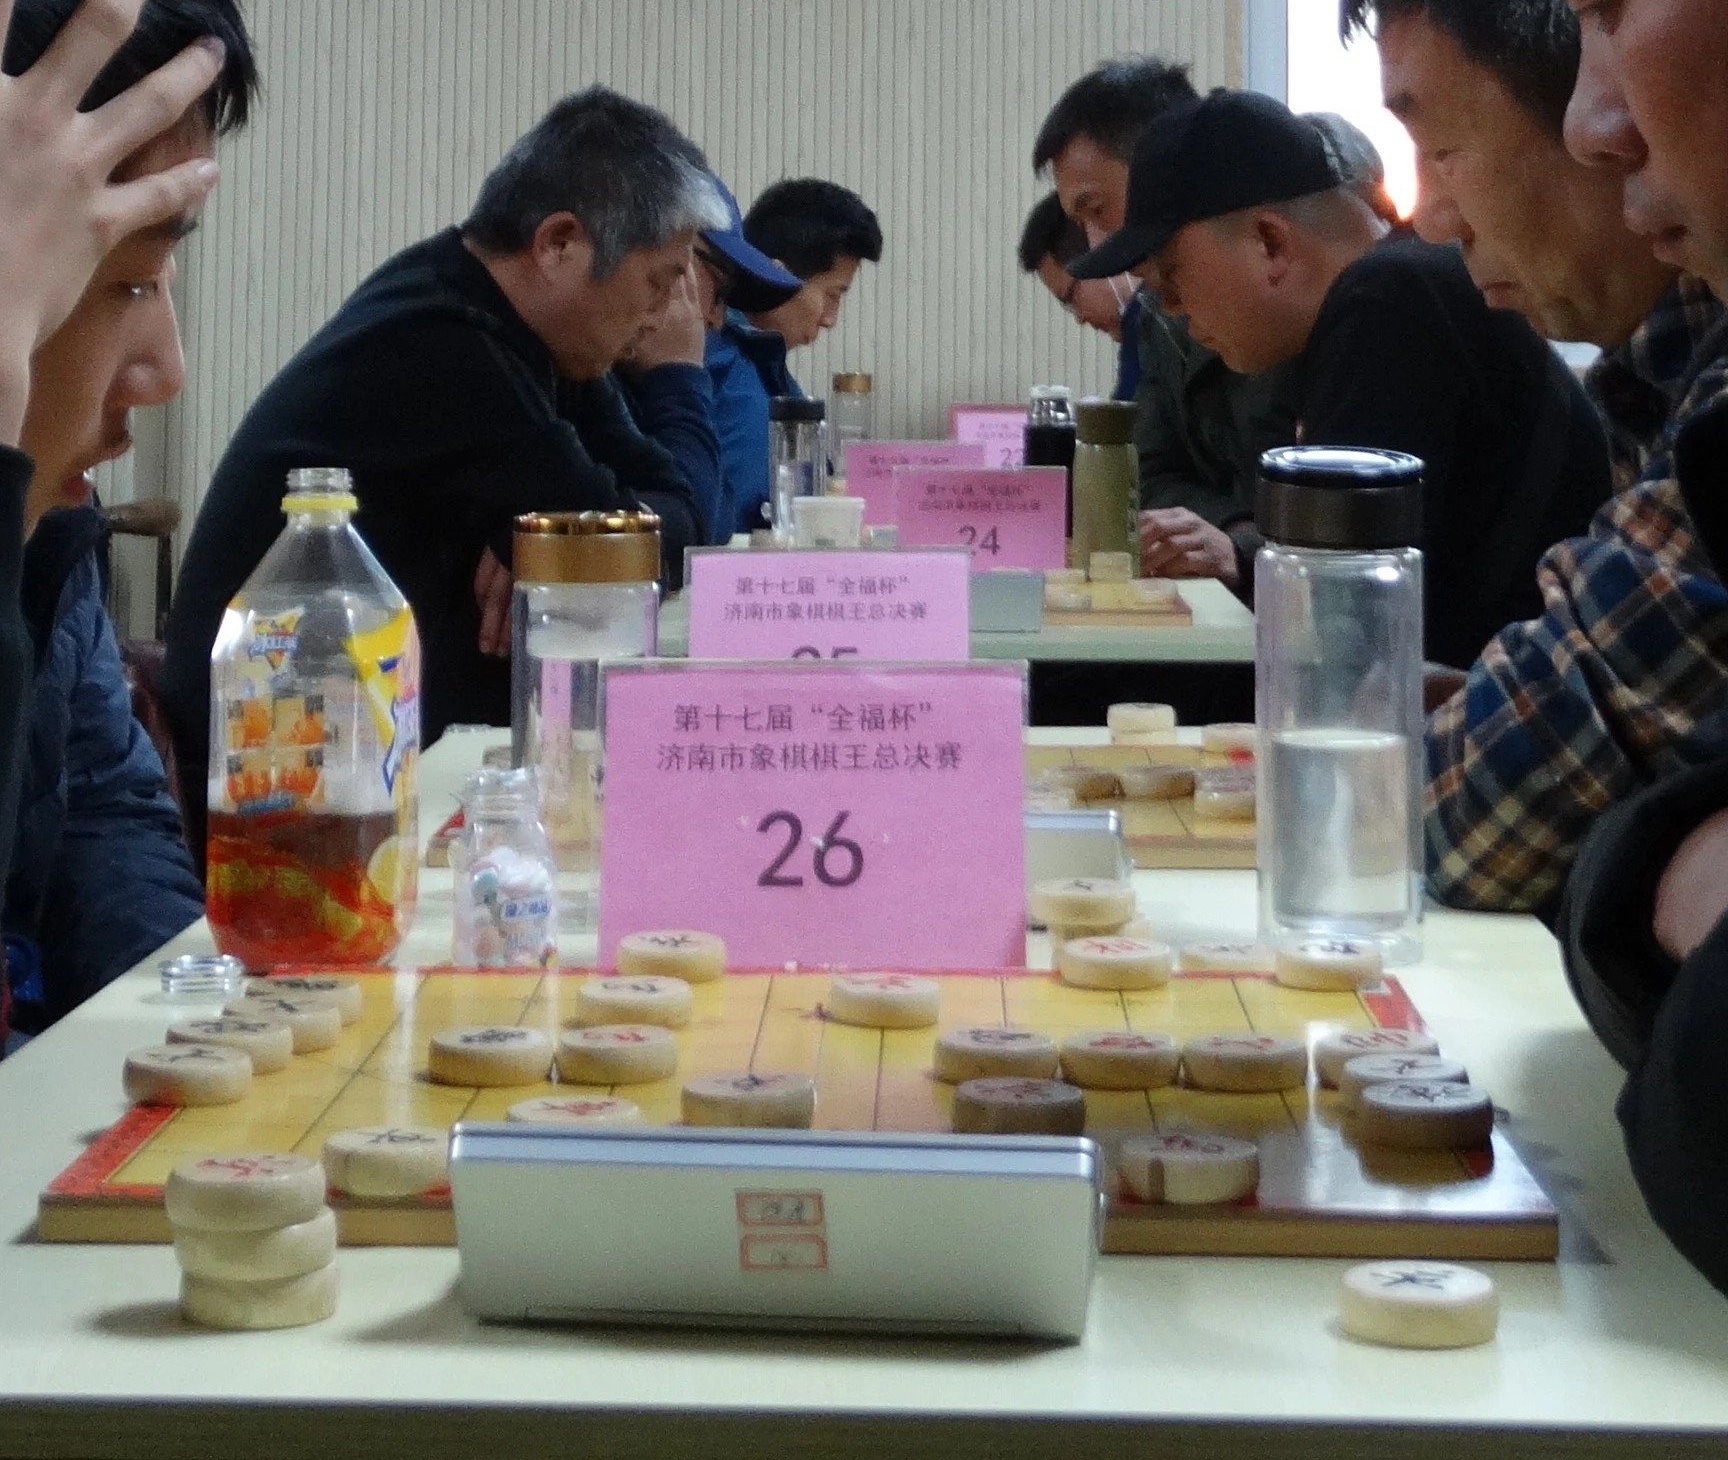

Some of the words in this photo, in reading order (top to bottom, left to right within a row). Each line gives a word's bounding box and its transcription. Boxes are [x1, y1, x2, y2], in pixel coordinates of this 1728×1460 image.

[958, 524, 1000, 555] 24
[724, 601, 928, 621] 济南市象棋棋王总决赛
[656, 741, 962, 771] 济南市象棋棋王总决赛
[756, 809, 864, 887] 26
